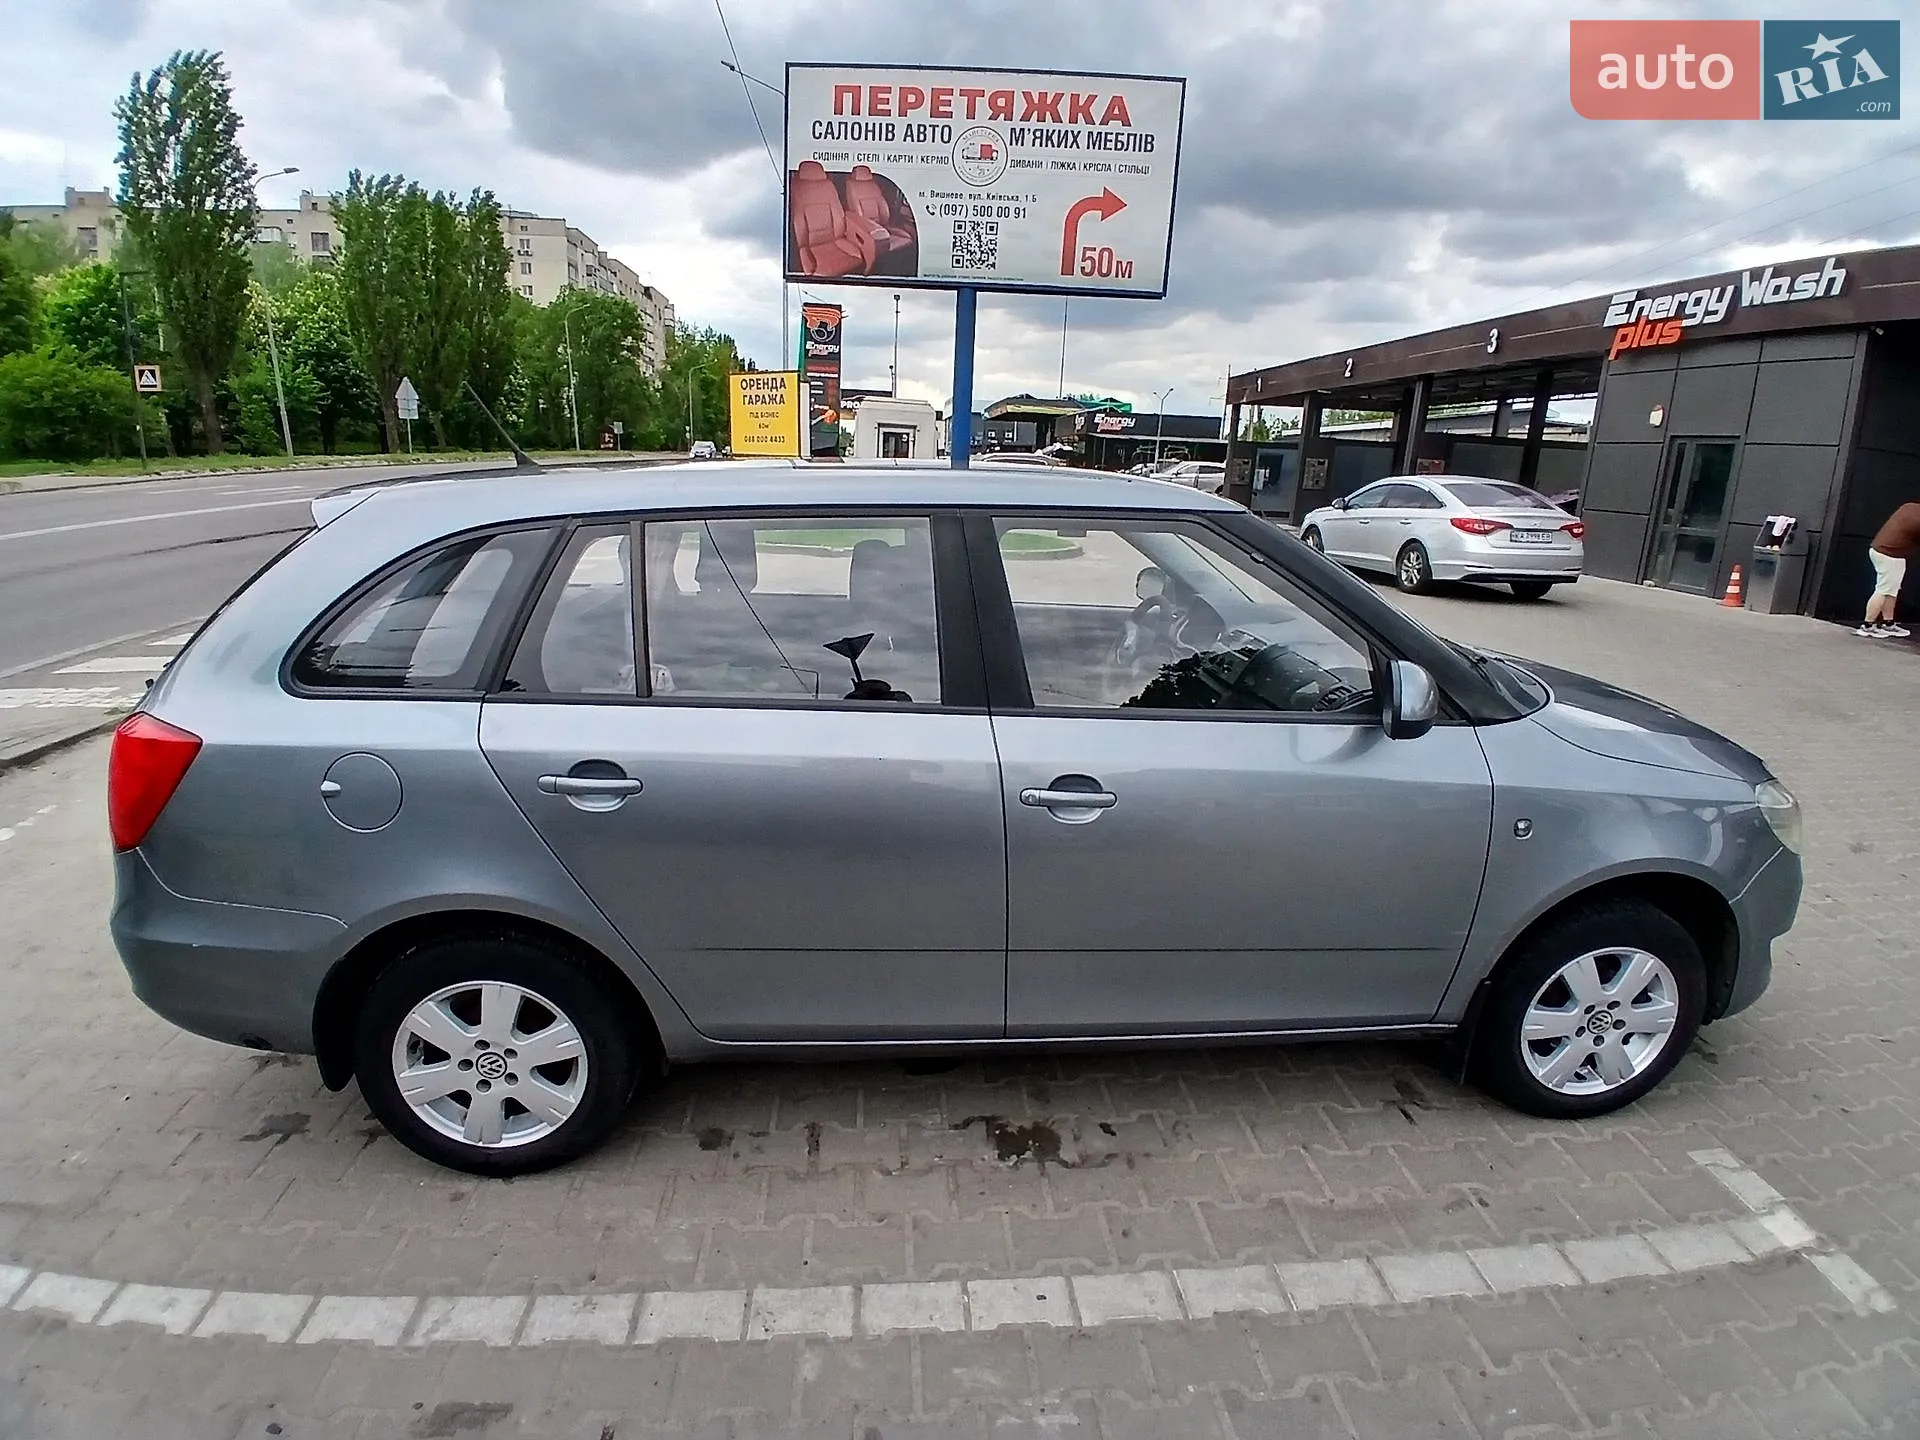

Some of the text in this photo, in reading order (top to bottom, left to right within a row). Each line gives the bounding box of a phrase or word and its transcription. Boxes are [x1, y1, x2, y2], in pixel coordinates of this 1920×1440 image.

[833, 84, 1132, 127] ПЕРЕТЯЖКА
[811, 119, 952, 144] САЛОНІВ АВТО
[1086, 131, 1155, 153] МЕБЛІВ
[812, 151, 949, 165] СИДІННЯ СТЕЛІ КАРТИ КЕРМО
[1009, 159, 1150, 175] ДИВАНИ ЛІЖКА КРІСЛА СТІЛЬЦІ
[939, 203, 1026, 219] (097) 500 00 91
[1602, 257, 1847, 328] Energy Wash
[1487, 328, 1499, 354] 3
[1608, 316, 1685, 361] plus
[806, 341, 839, 353] Energy
[1344, 357, 1353, 378] 2
[740, 377, 787, 392] ОРЕНДА
[1256, 377, 1262, 393] 1
[742, 393, 785, 405] ГАРАЖА
[1094, 413, 1136, 427] Energy
